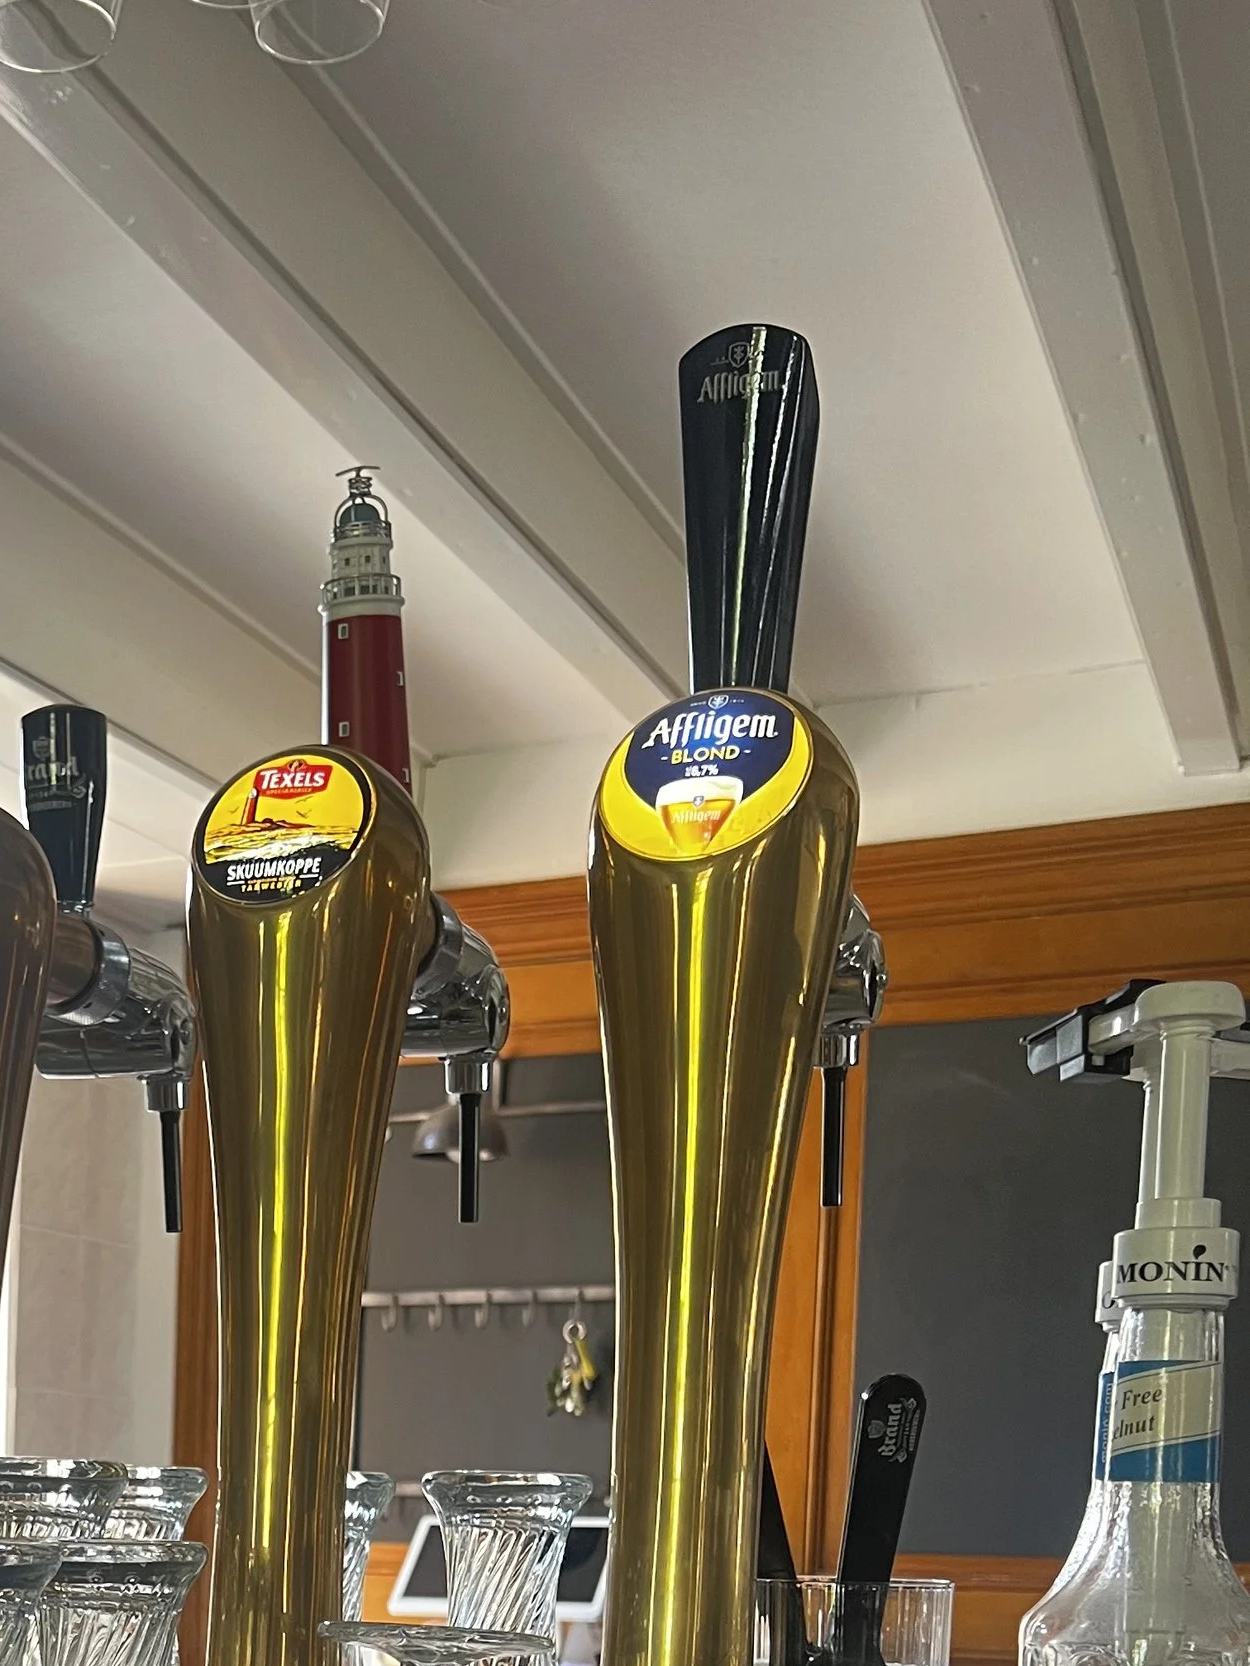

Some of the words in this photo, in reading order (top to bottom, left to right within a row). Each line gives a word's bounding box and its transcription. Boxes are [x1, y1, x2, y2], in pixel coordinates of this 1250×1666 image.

[641, 710, 778, 749] Affligem
[671, 745, 740, 765] BLOND
[26, 756, 79, 780] rand
[260, 768, 326, 790] TEXELS
[227, 857, 322, 881] SKUUMKOPPE
[1116, 1252, 1225, 1284] MONIN
[1121, 1388, 1163, 1411] Free
[1113, 1413, 1156, 1440] elnut
